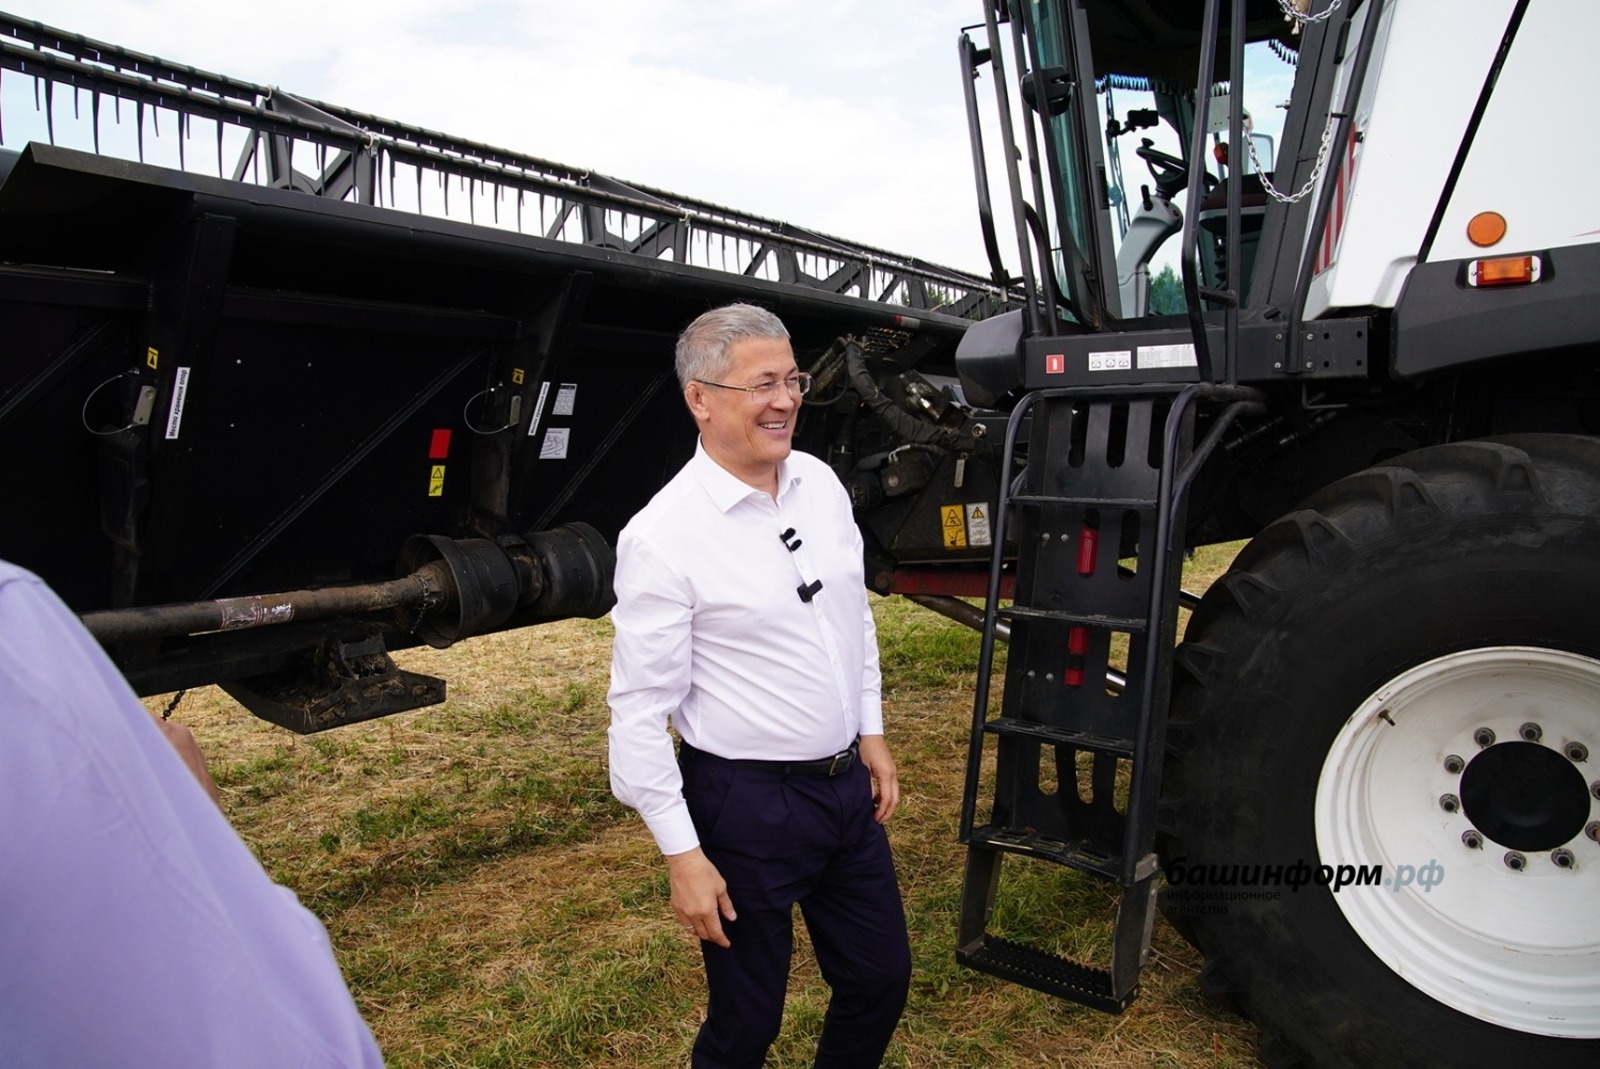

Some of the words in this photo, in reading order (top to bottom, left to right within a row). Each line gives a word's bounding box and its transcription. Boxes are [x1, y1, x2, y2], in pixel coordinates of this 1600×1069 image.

[169, 416, 178, 436] Место
[174, 386, 184, 415] хранения
[179, 370, 188, 385] опор
